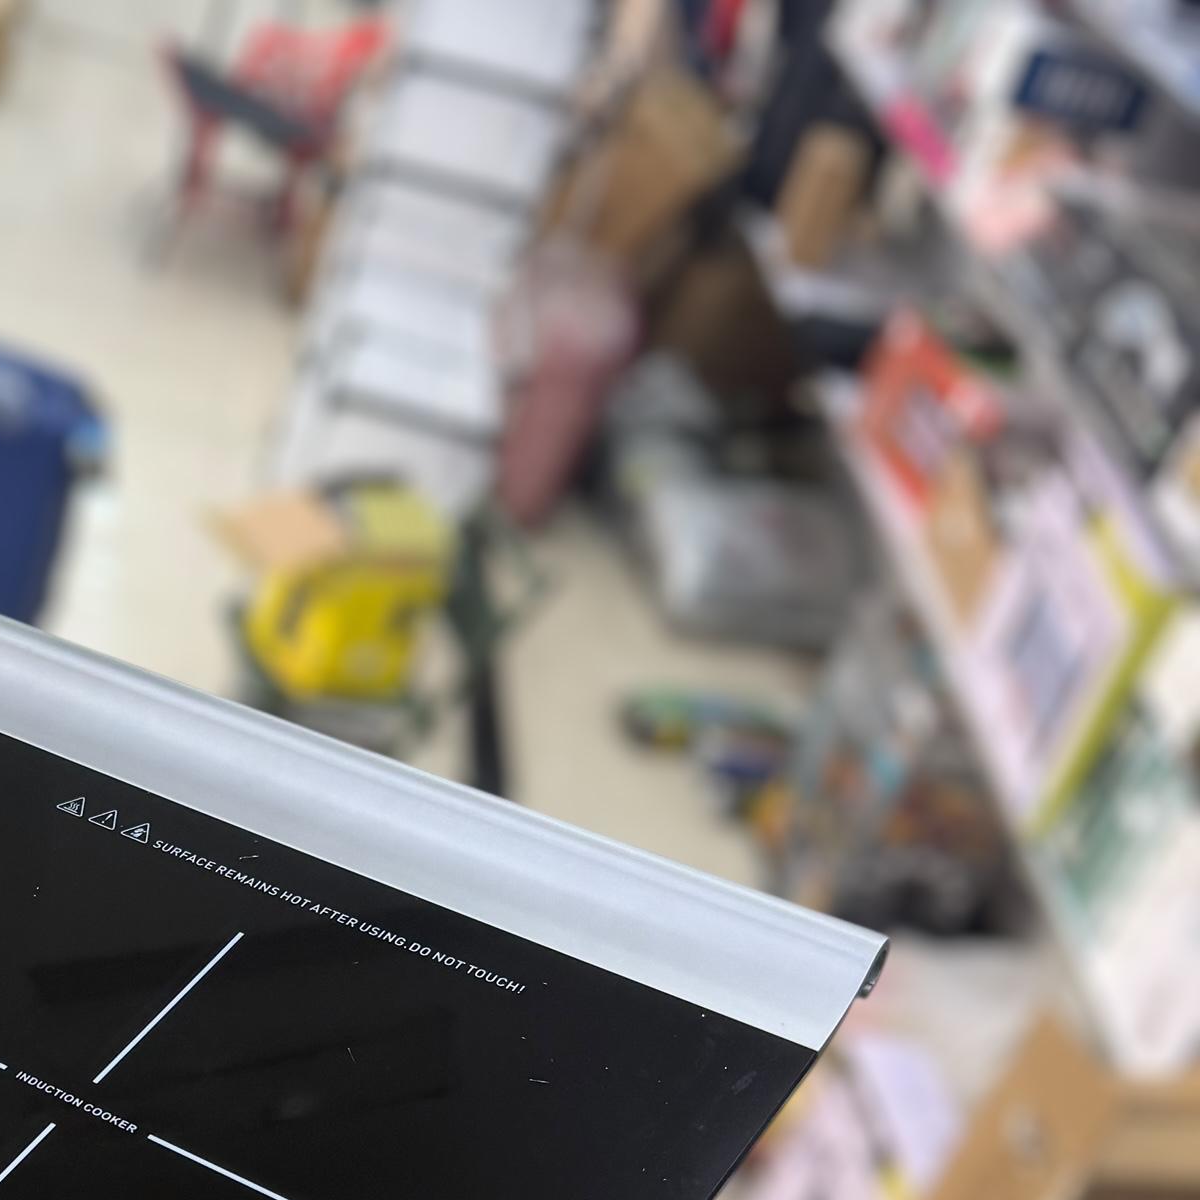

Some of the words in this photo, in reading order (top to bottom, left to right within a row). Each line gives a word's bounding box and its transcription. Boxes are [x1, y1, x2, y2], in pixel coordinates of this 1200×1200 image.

[152, 840, 216, 870] SURFACE
[214, 865, 280, 896] REMAINS
[279, 890, 312, 908] HOT
[309, 903, 359, 928] AFTER
[431, 951, 467, 970] NOT
[466, 964, 526, 994] TOUCH!
[15, 1071, 84, 1108] INDUCTION
[83, 1103, 138, 1134] COOKER
